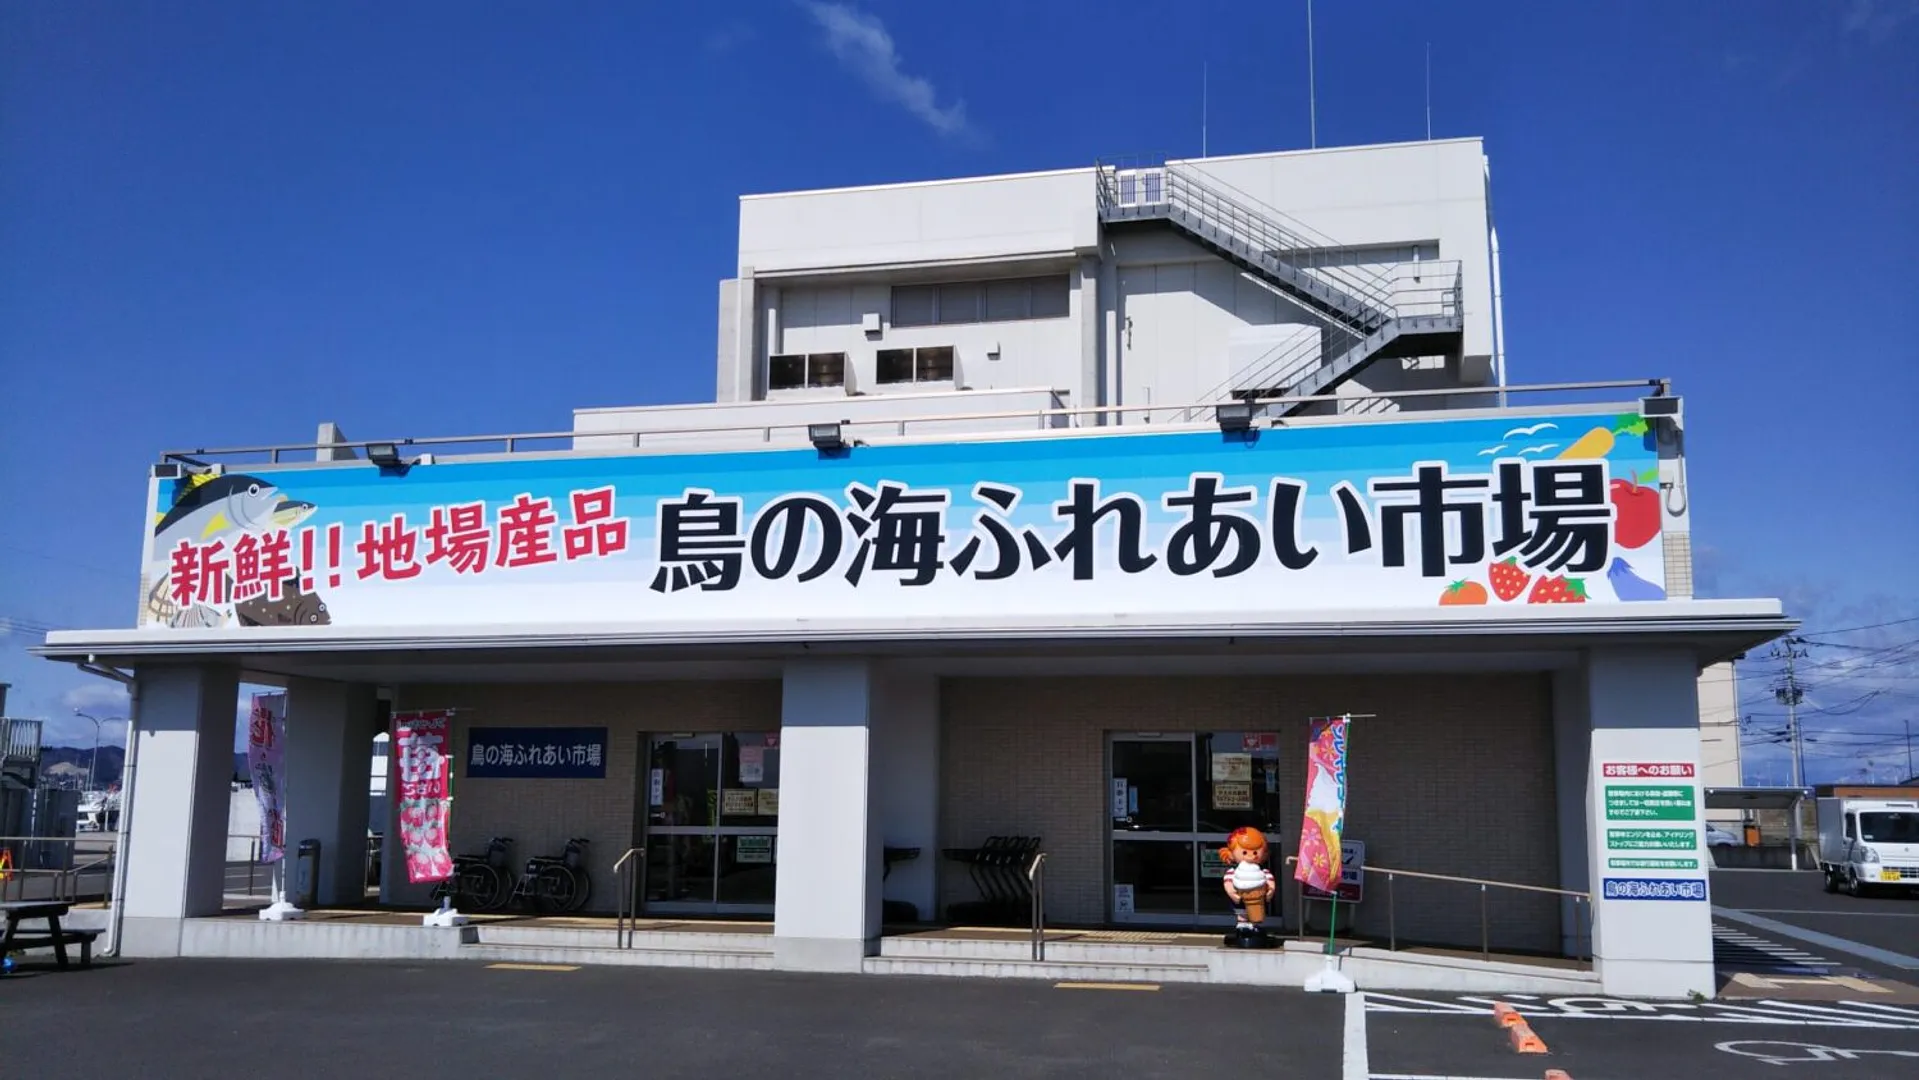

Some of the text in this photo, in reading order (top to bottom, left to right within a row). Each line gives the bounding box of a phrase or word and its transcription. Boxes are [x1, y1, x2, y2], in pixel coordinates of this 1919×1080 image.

[649, 460, 1614, 593] 鳥の海ふれあい市場
[470, 743, 602, 767] 鳥の海ふれあい市場
[1605, 765, 1692, 776] お客様へのお願い
[1606, 881, 1704, 897] 鳥の海ふれあい市場
